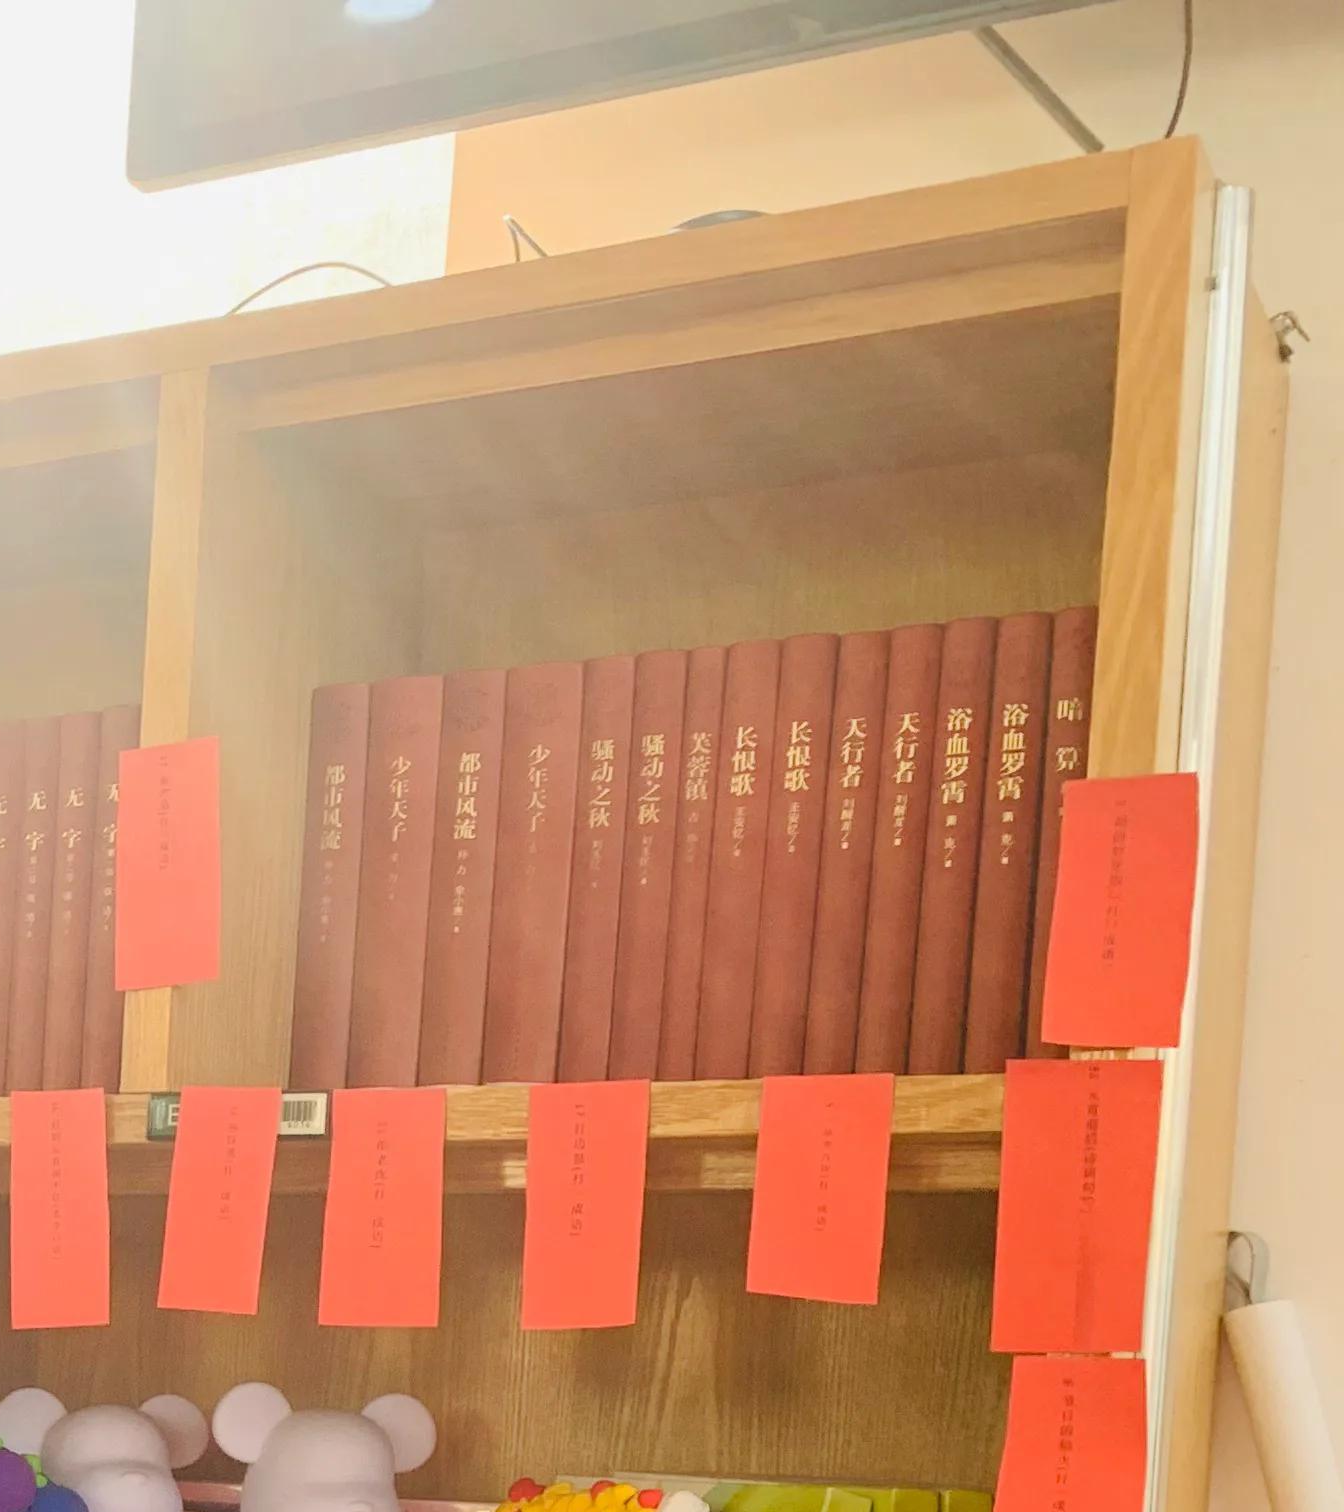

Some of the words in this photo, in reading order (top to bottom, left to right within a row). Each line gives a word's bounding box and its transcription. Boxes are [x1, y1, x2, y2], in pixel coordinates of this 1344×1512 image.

[685, 731, 712, 800] 芙蓉镇
[730, 725, 757, 797] 长恨歌
[783, 720, 812, 793] 长恨歌
[839, 718, 866, 789] 天行者
[892, 712, 920, 786] 天行者
[941, 707, 973, 806] 浴血罗霄
[997, 703, 1030, 801] 浴血罗霄
[1056, 696, 1083, 773] 暗算
[62, 786, 85, 849] 无字
[320, 765, 346, 850] 都市风流
[389, 756, 413, 842] 少年天子
[453, 752, 481, 839] 都市风流
[527, 744, 551, 833] 少年天子
[588, 739, 615, 829] 骚动之秋
[638, 734, 665, 825] 骚动之秋
[25, 789, 49, 852] 无字
